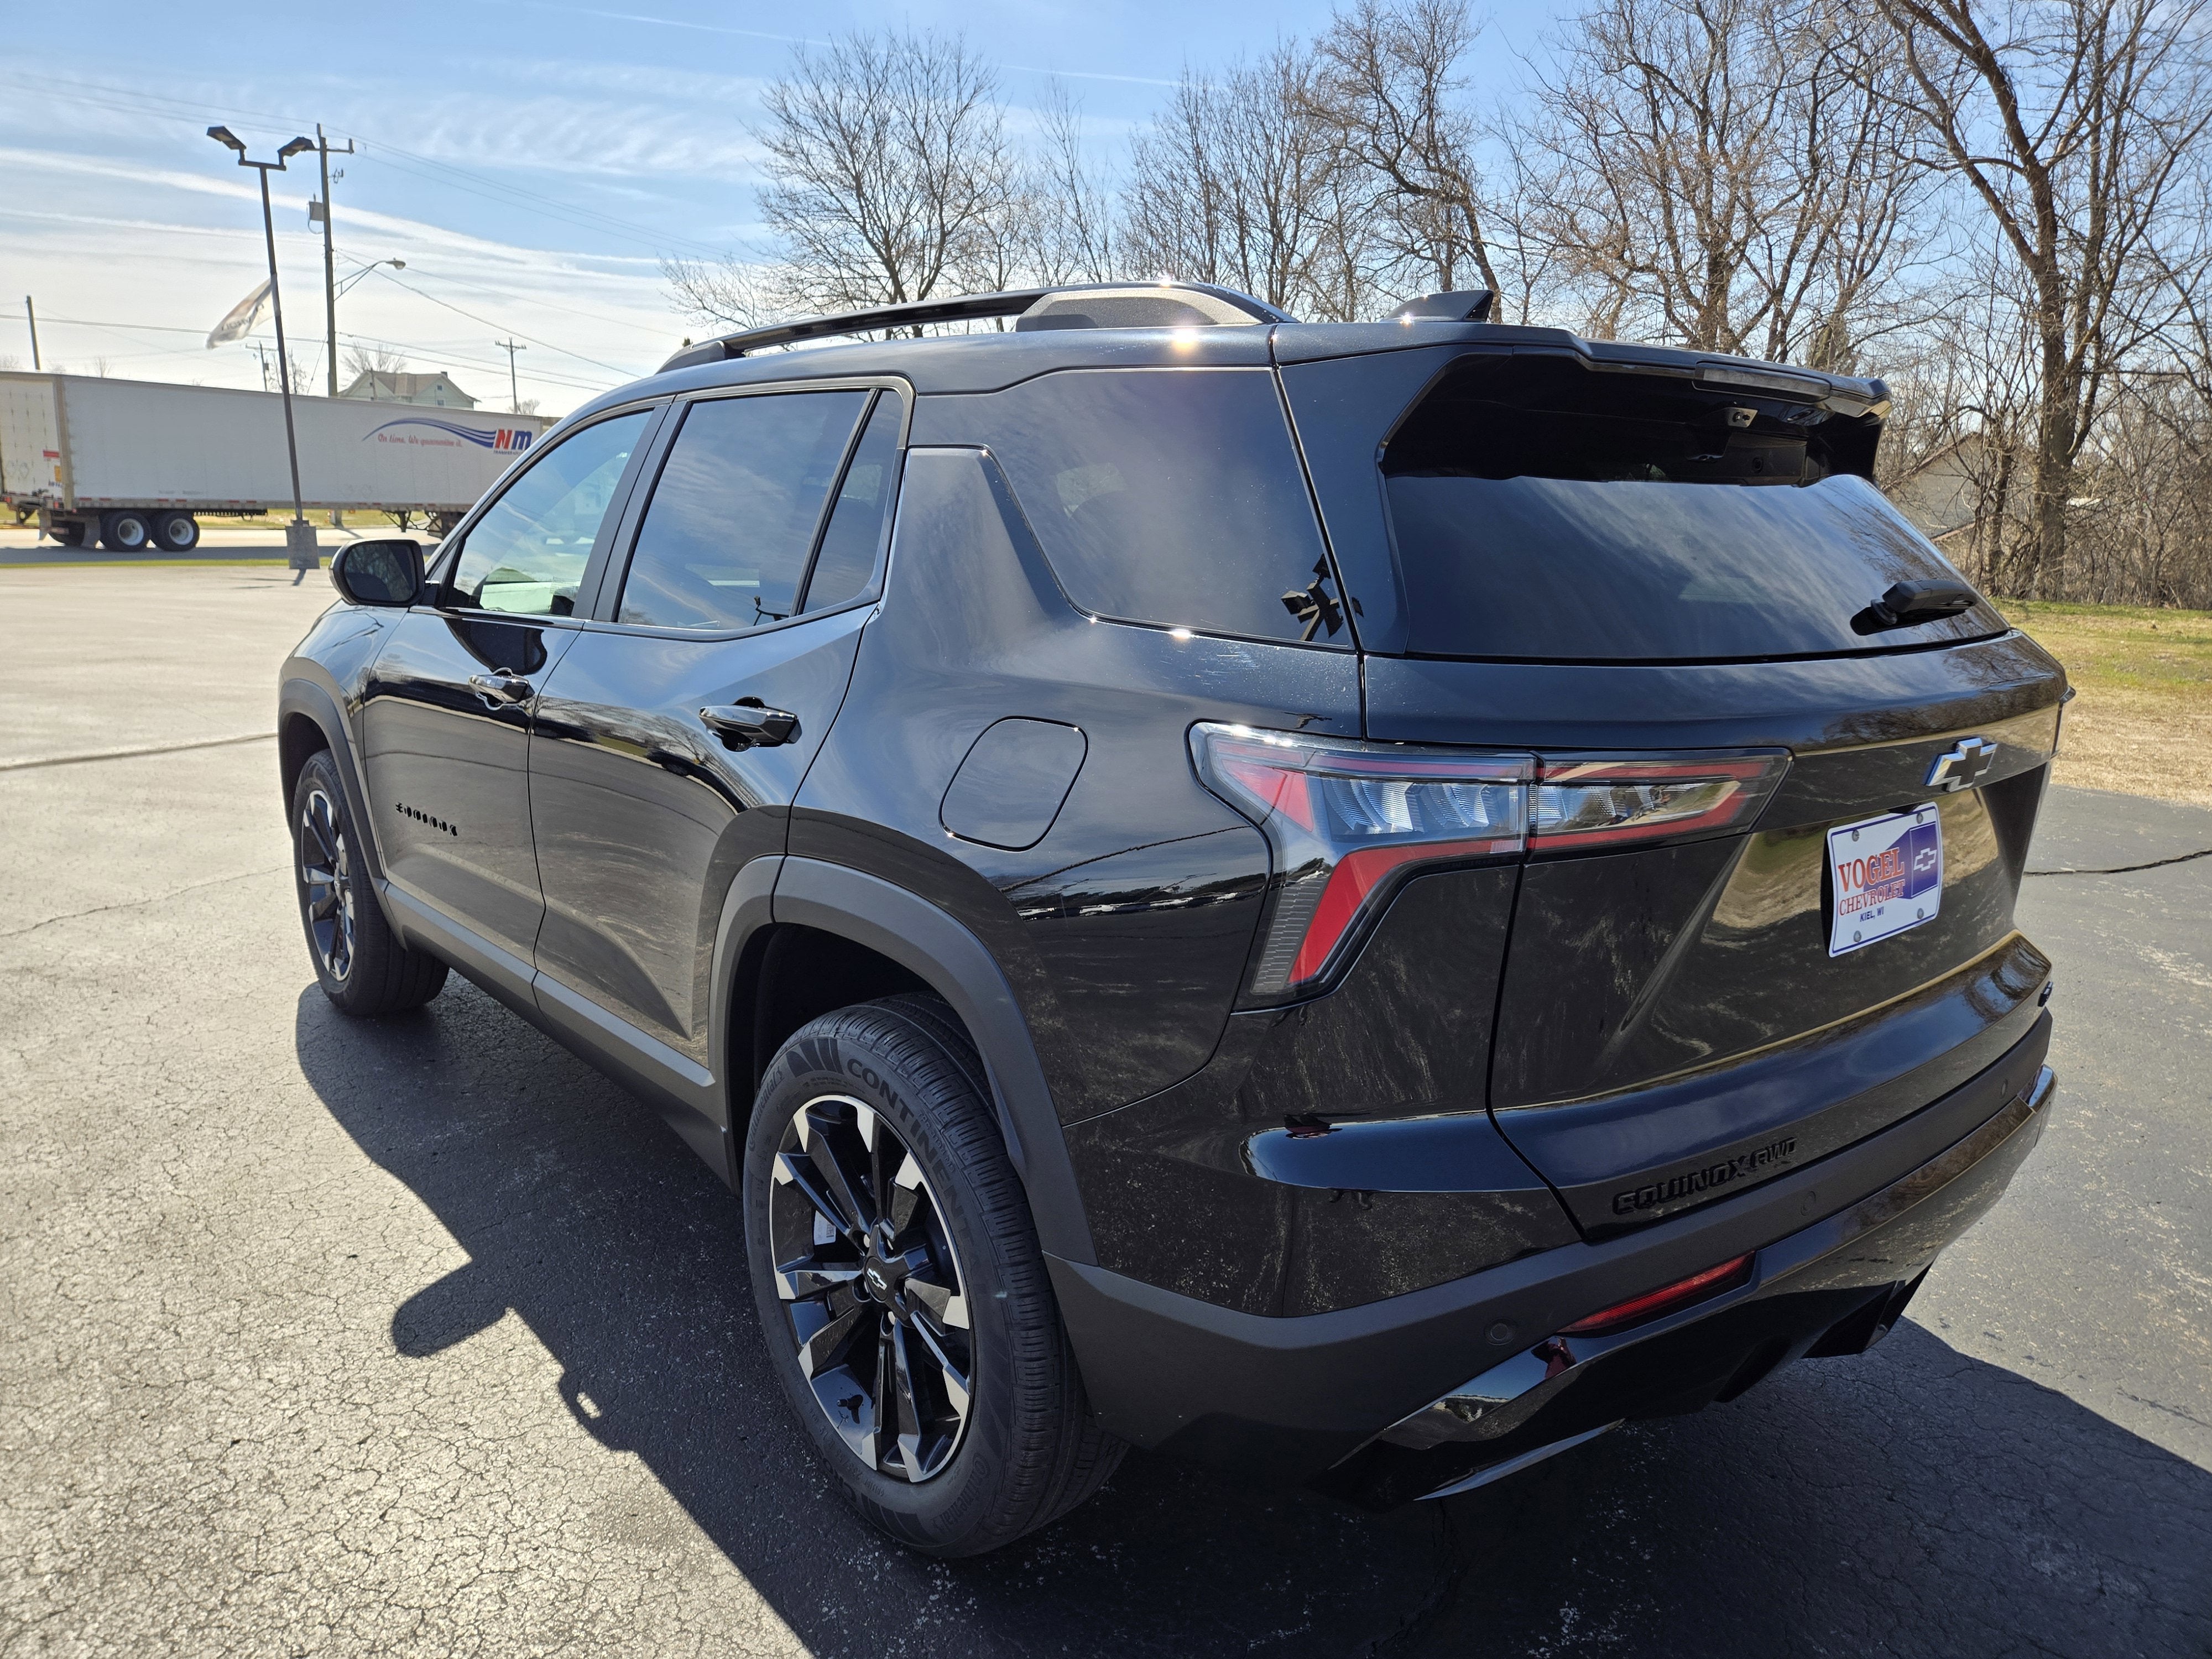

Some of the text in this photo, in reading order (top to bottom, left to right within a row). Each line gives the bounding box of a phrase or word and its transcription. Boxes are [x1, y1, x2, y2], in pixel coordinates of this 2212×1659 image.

[1838, 847, 1905, 893] VOGEL
[1839, 879, 1905, 916] CHEVROLET
[1859, 906, 1885, 922] KIEL, WI
[1611, 1154, 1746, 1215] EQUINOX
